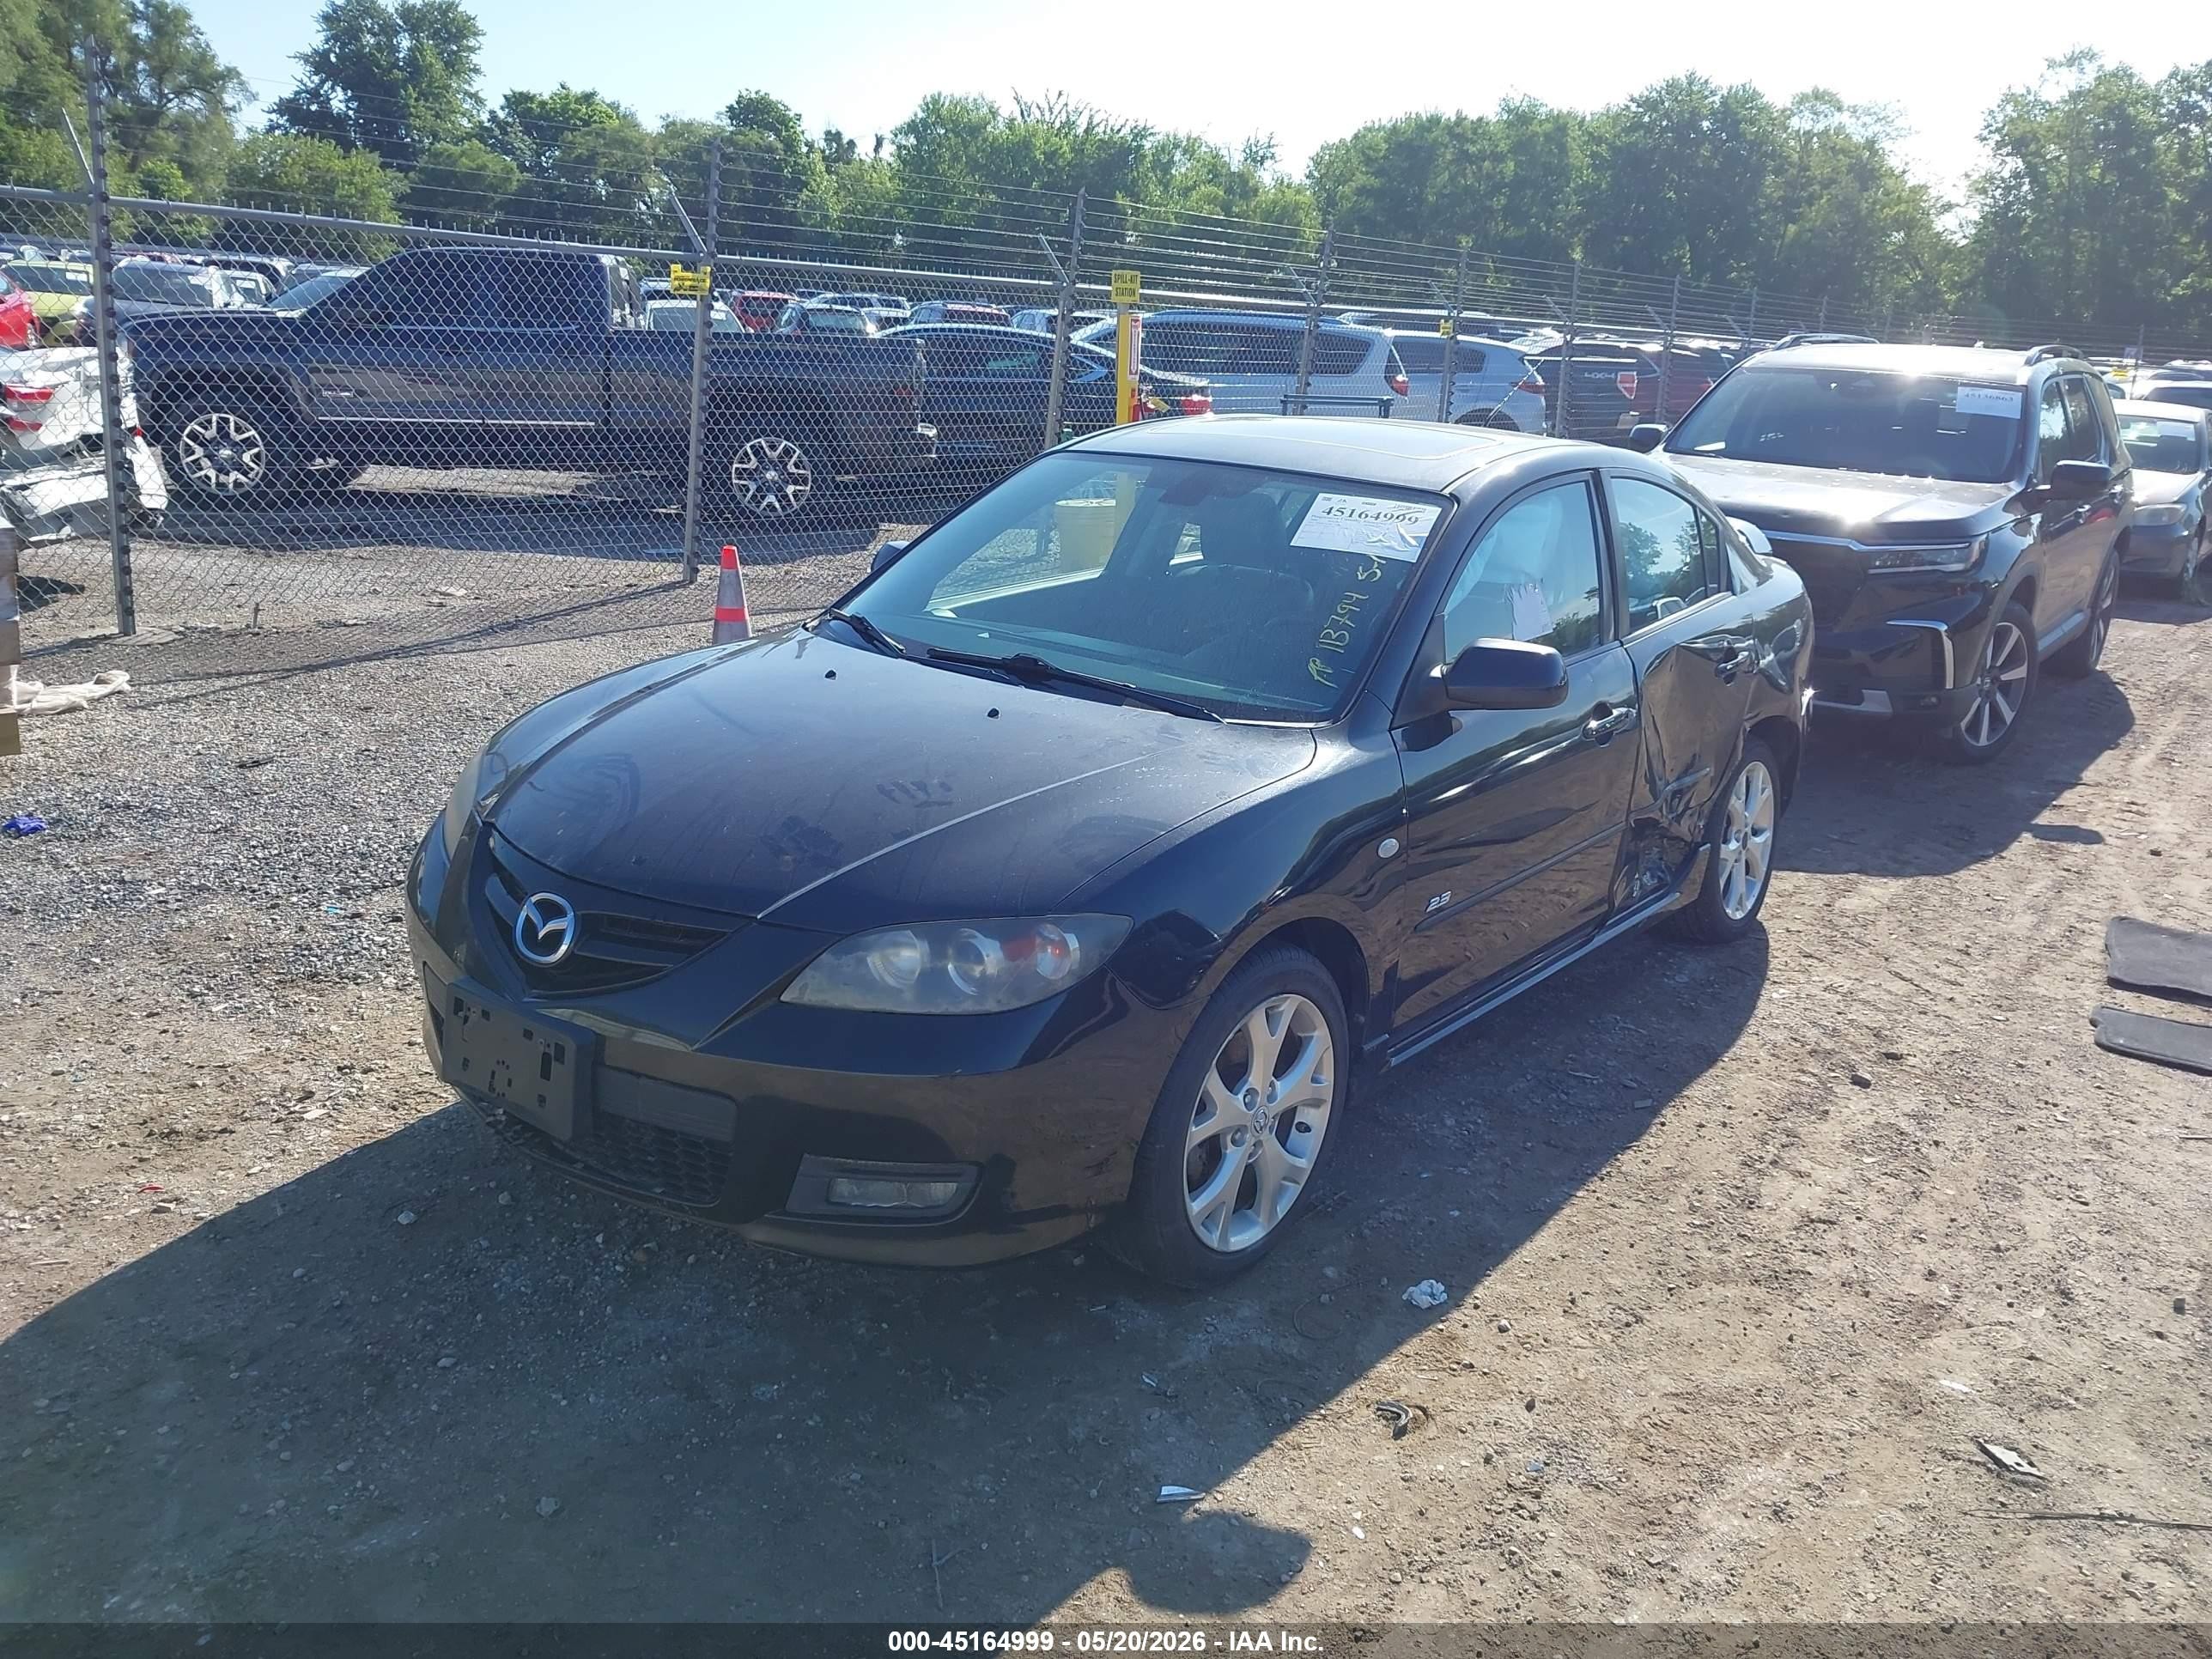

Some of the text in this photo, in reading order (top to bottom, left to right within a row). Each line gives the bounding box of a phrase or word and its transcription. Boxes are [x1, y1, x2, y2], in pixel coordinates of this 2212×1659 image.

[1114, 274, 1138, 284] SPILL-KIT
[1115, 287, 1136, 297] STATION
[1322, 505, 1419, 525] 45164999
